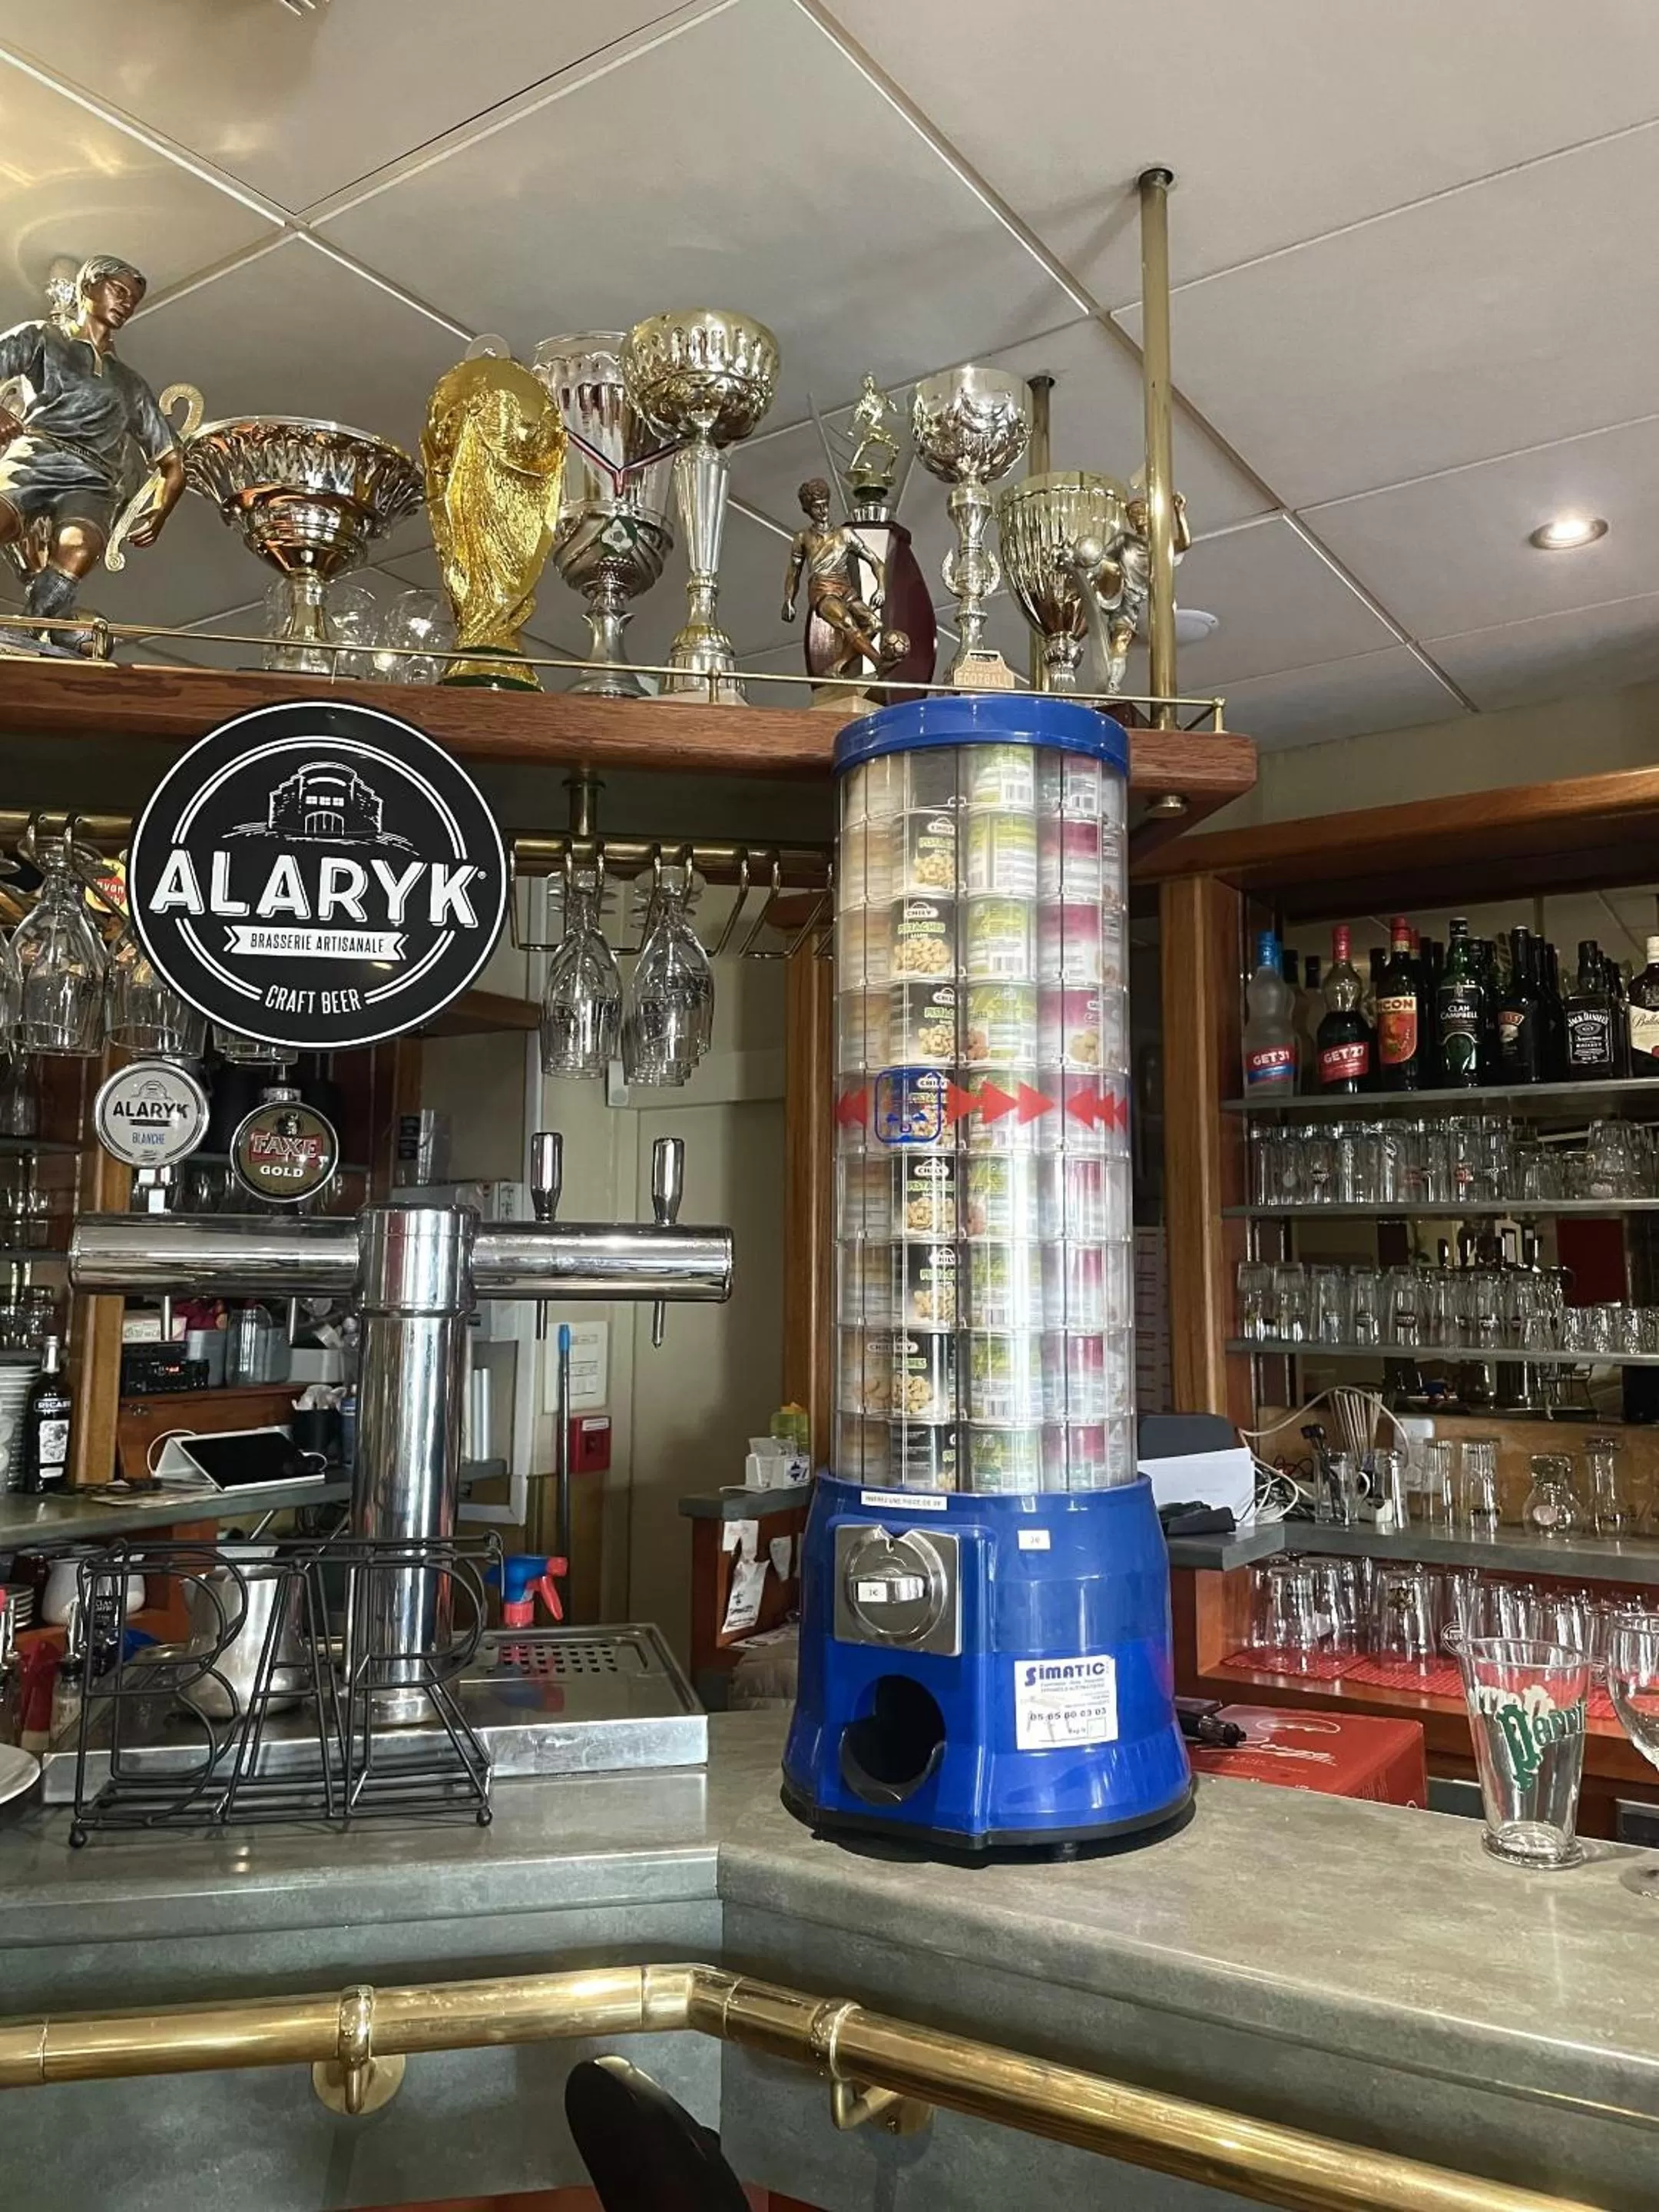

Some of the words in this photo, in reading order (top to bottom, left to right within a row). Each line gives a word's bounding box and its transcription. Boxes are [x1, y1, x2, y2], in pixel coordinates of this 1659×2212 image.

[149, 849, 479, 928] ALARYK
[250, 932, 312, 951] BRASSERIE
[316, 935, 384, 953] ARTISANALE
[265, 984, 316, 1014] CRAFT
[321, 988, 362, 1014] BEER
[1253, 1052, 1278, 1065] GET
[1323, 1048, 1349, 1065] GET
[113, 1101, 189, 1119] ALARYK
[132, 1132, 166, 1145] BLANCHE
[252, 1133, 317, 1158] FAXE
[260, 1164, 304, 1177] GOLD
[38, 1400, 71, 1409] RICAR
